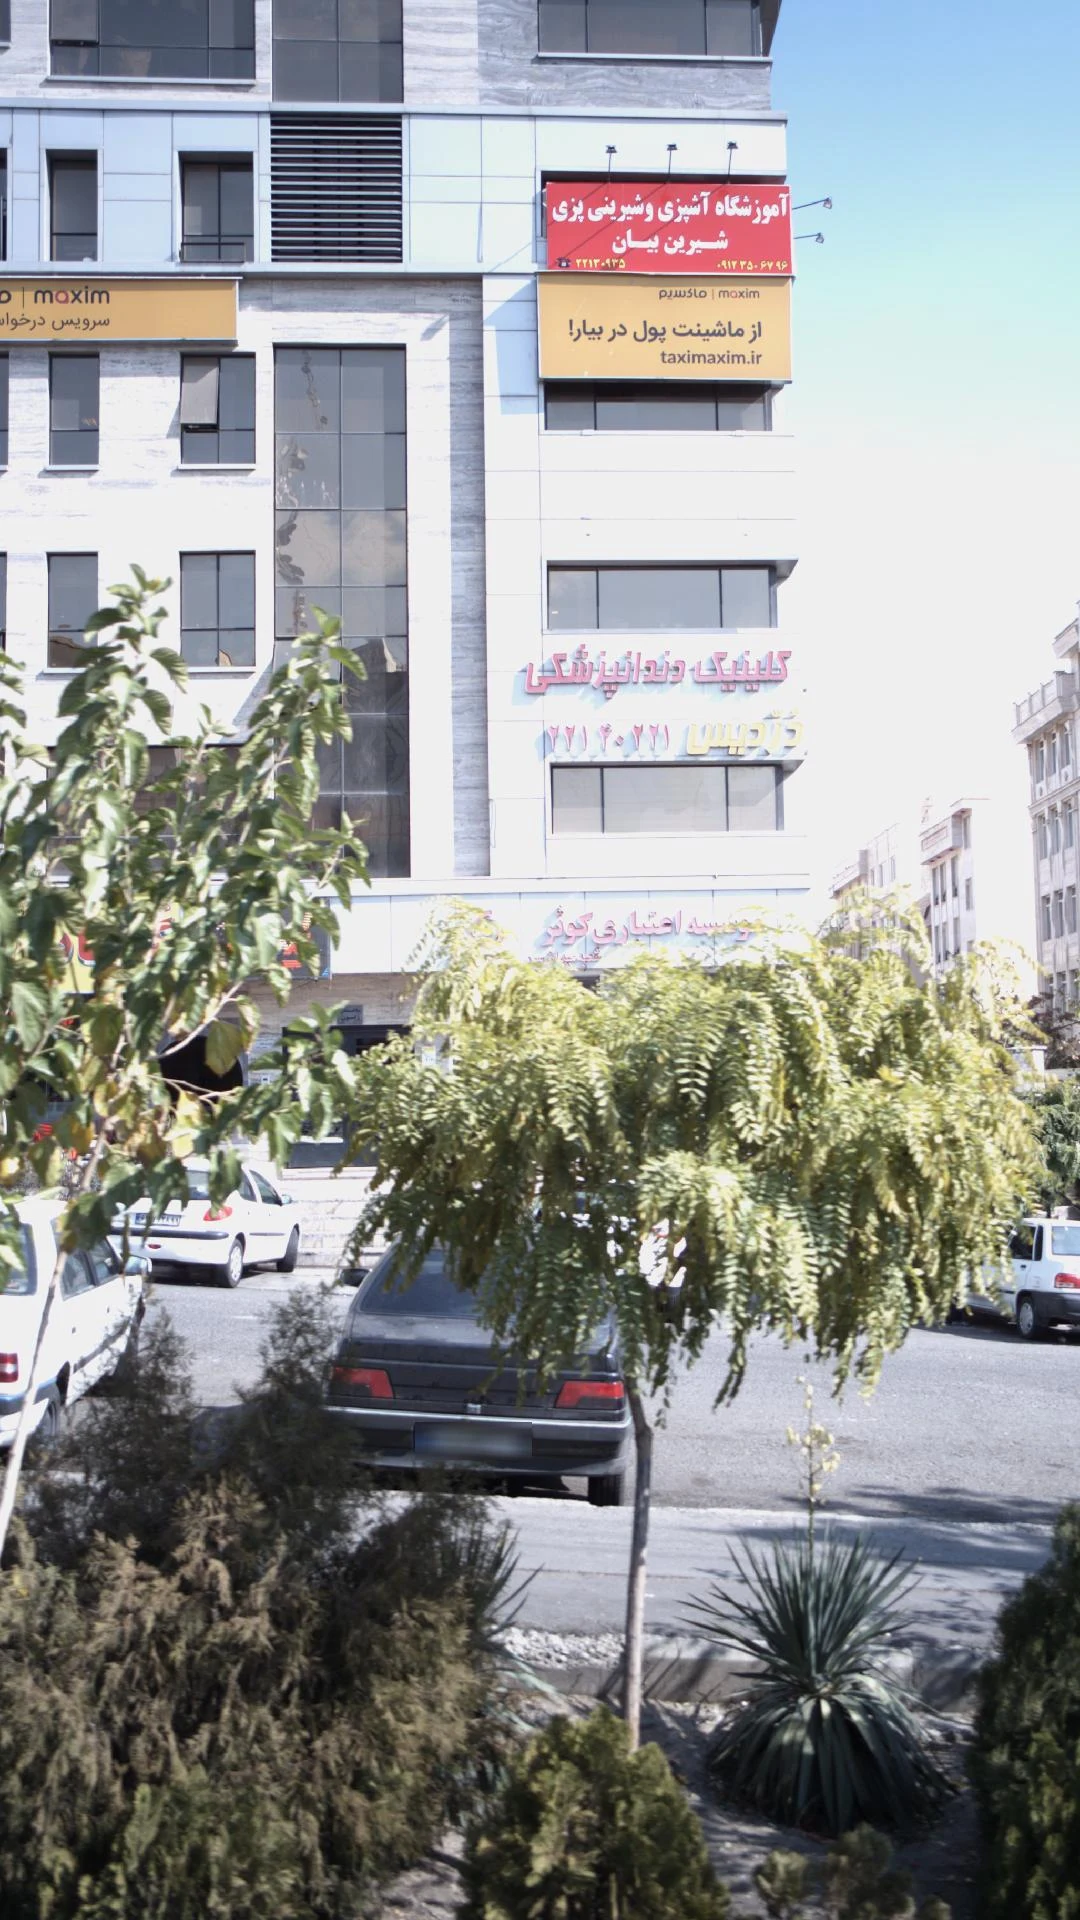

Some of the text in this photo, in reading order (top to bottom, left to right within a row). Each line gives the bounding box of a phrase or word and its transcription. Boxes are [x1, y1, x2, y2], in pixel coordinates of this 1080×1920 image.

[552, 199, 584, 223] پزی
[657, 192, 710, 224] آشپزی
[714, 192, 790, 224] آموزشگاه
[612, 229, 729, 255] شیرین بیان
[34, 285, 111, 305] maxim
[658, 288, 708, 301] ماکسیم
[718, 288, 760, 299] maxim
[51, 316, 111, 331] سرویس
[608, 323, 628, 342] در
[633, 320, 667, 344] پول
[672, 320, 745, 342] ماشینت
[748, 320, 762, 344] از
[660, 350, 763, 366] taximaxim.ir
[524, 643, 792, 699] کلینیک دندانپزشکی
[592, 909, 682, 945] اعتباری
